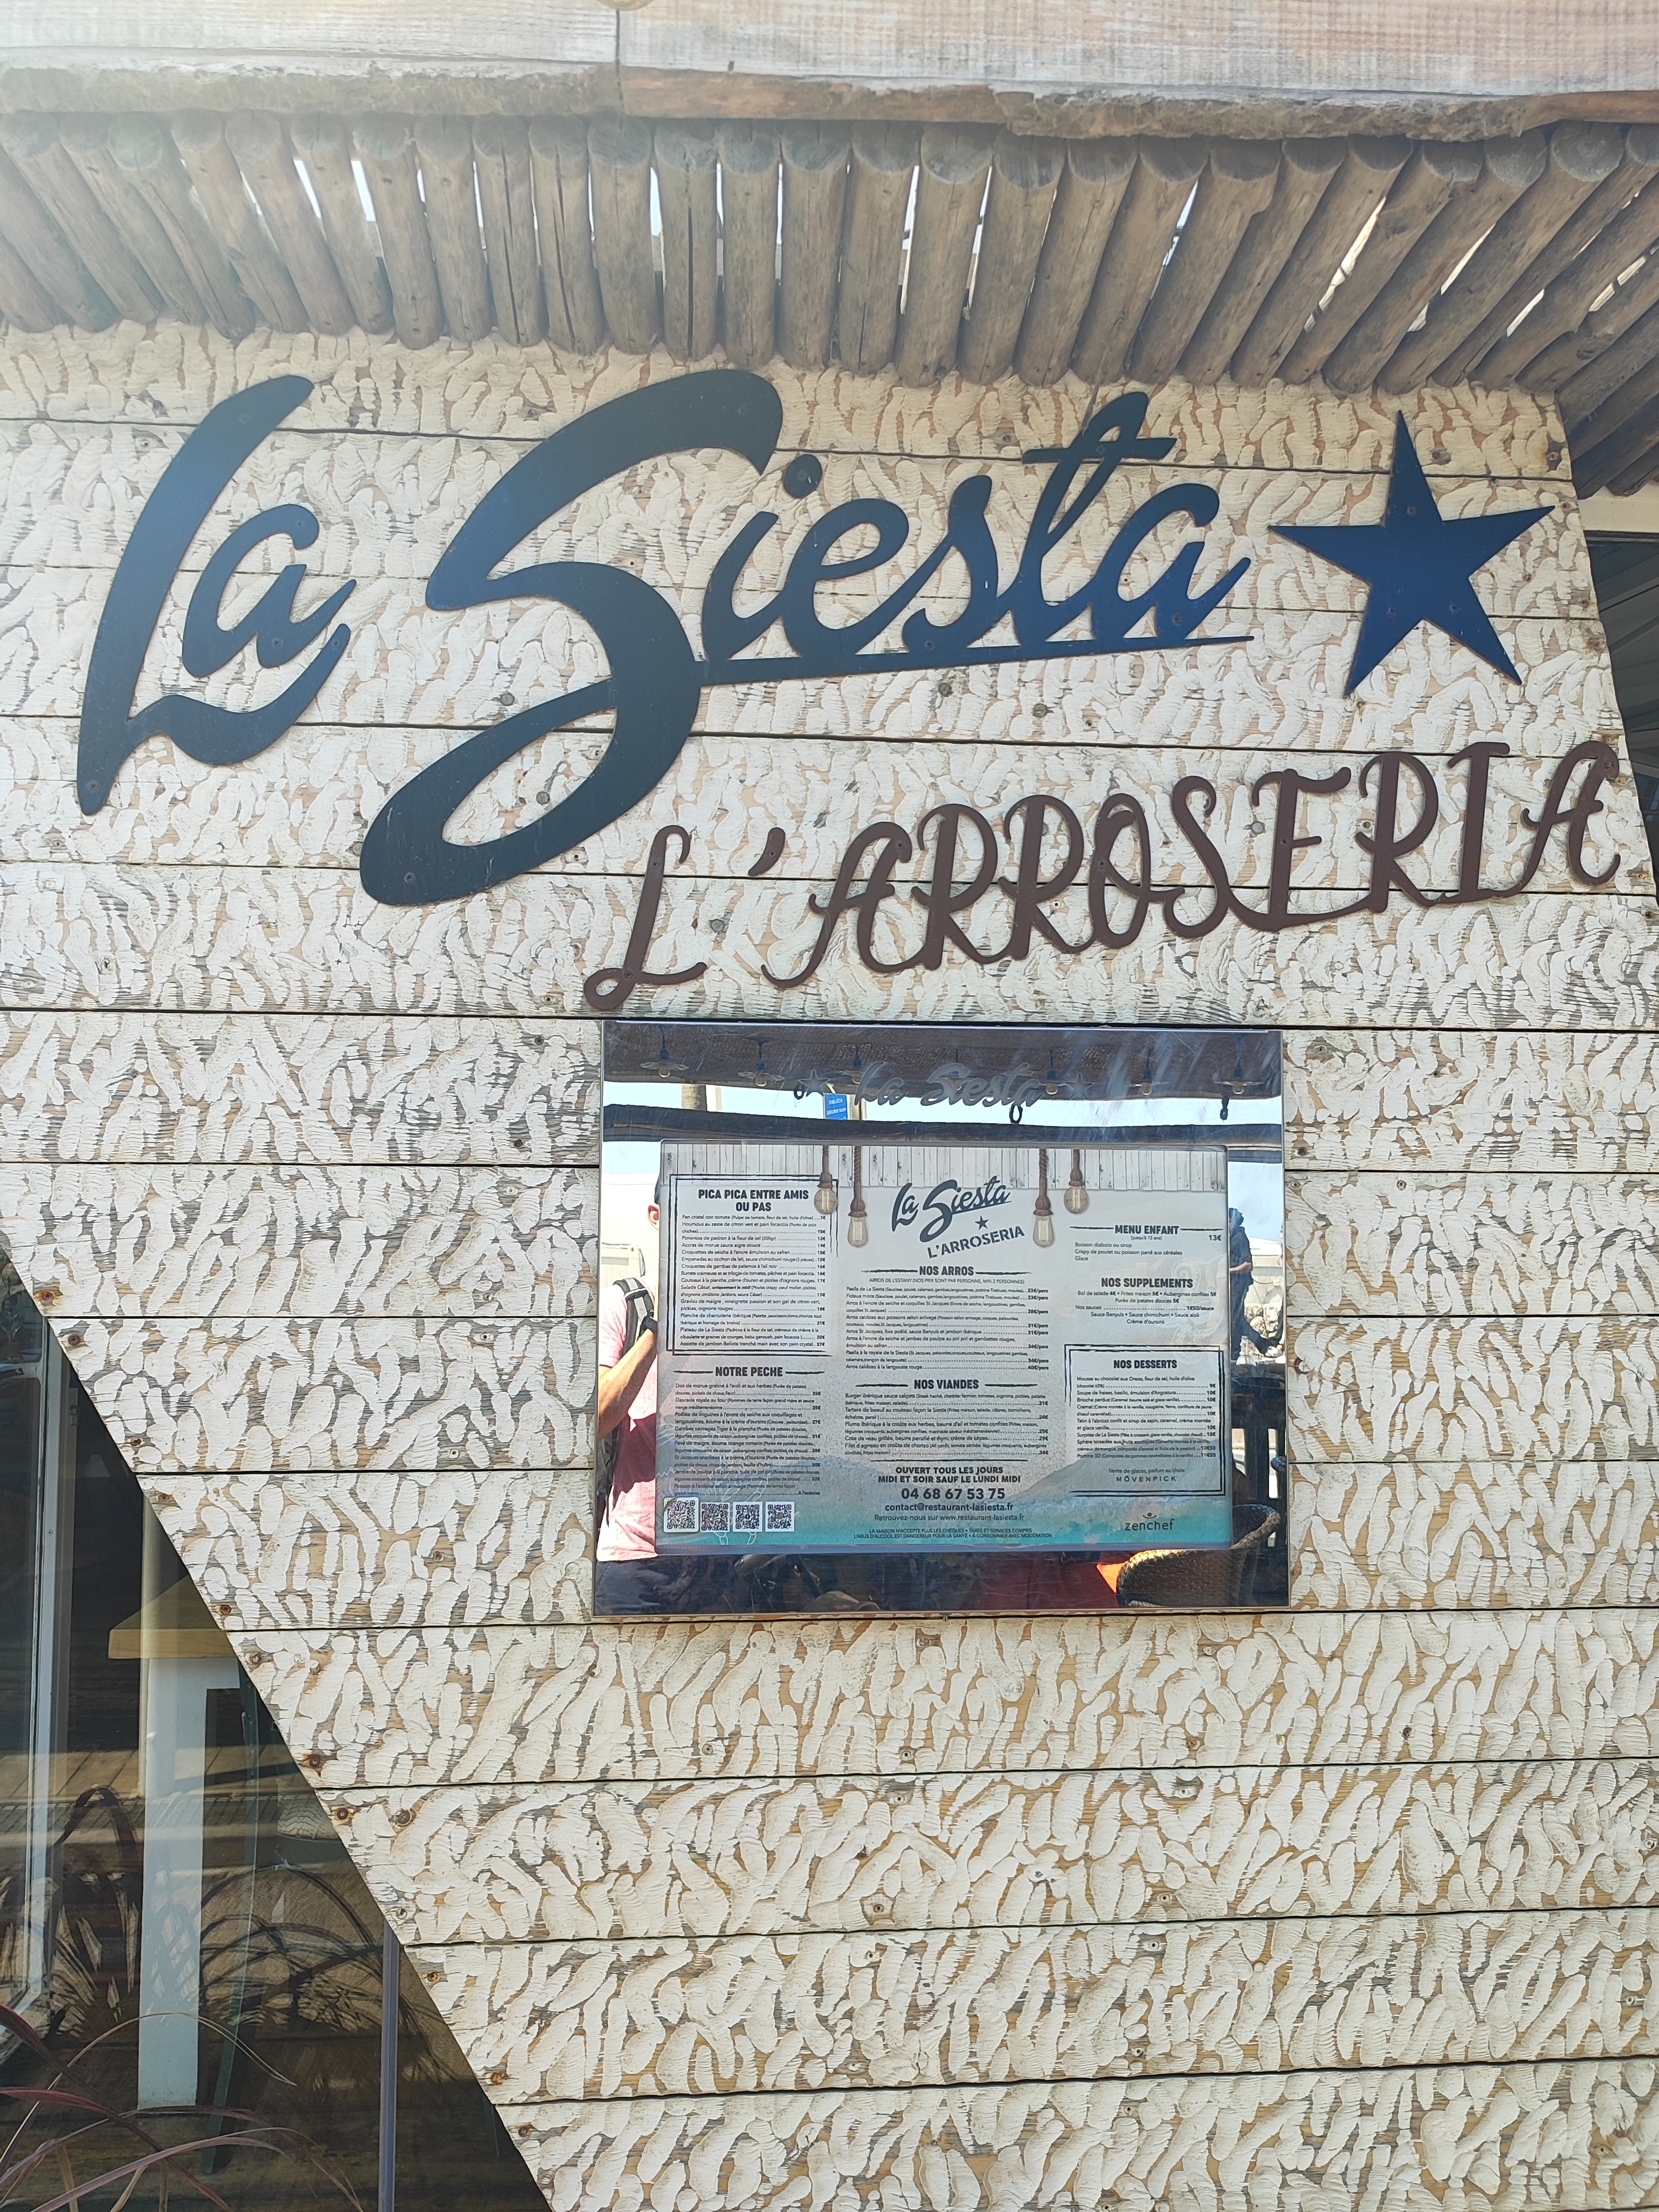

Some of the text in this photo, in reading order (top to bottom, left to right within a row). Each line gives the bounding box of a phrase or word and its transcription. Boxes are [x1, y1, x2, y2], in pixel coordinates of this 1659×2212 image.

[77, 368, 1254, 907] La Siesta
[584, 740, 1623, 1012] L'ARROSERIA
[855, 1061, 1047, 1108] La Siesta
[698, 1190, 808, 1199] PICA PICA ENTRE AMIS
[735, 1202, 771, 1211] OU PAS
[891, 1175, 1012, 1242] La Siesta
[1115, 1225, 1179, 1234] MENU ENFANT
[927, 1226, 1025, 1259] L'ARROSERIA
[919, 1266, 974, 1276] NOS ARROS
[1101, 1278, 1193, 1288] NOS SUPPLEMENTS
[1113, 1360, 1177, 1369] NOS DESSERTS
[716, 1367, 783, 1376] NOTRE PECHE
[914, 1380, 979, 1389] NOS VIANDES
[976, 1467, 1003, 1475] JOURS
[901, 1488, 1005, 1499] 04 68 67 53 75
[885, 1503, 1014, 1511] contact@restaurant-lasiesta.fr
[1125, 1517, 1175, 1531] zenchef
